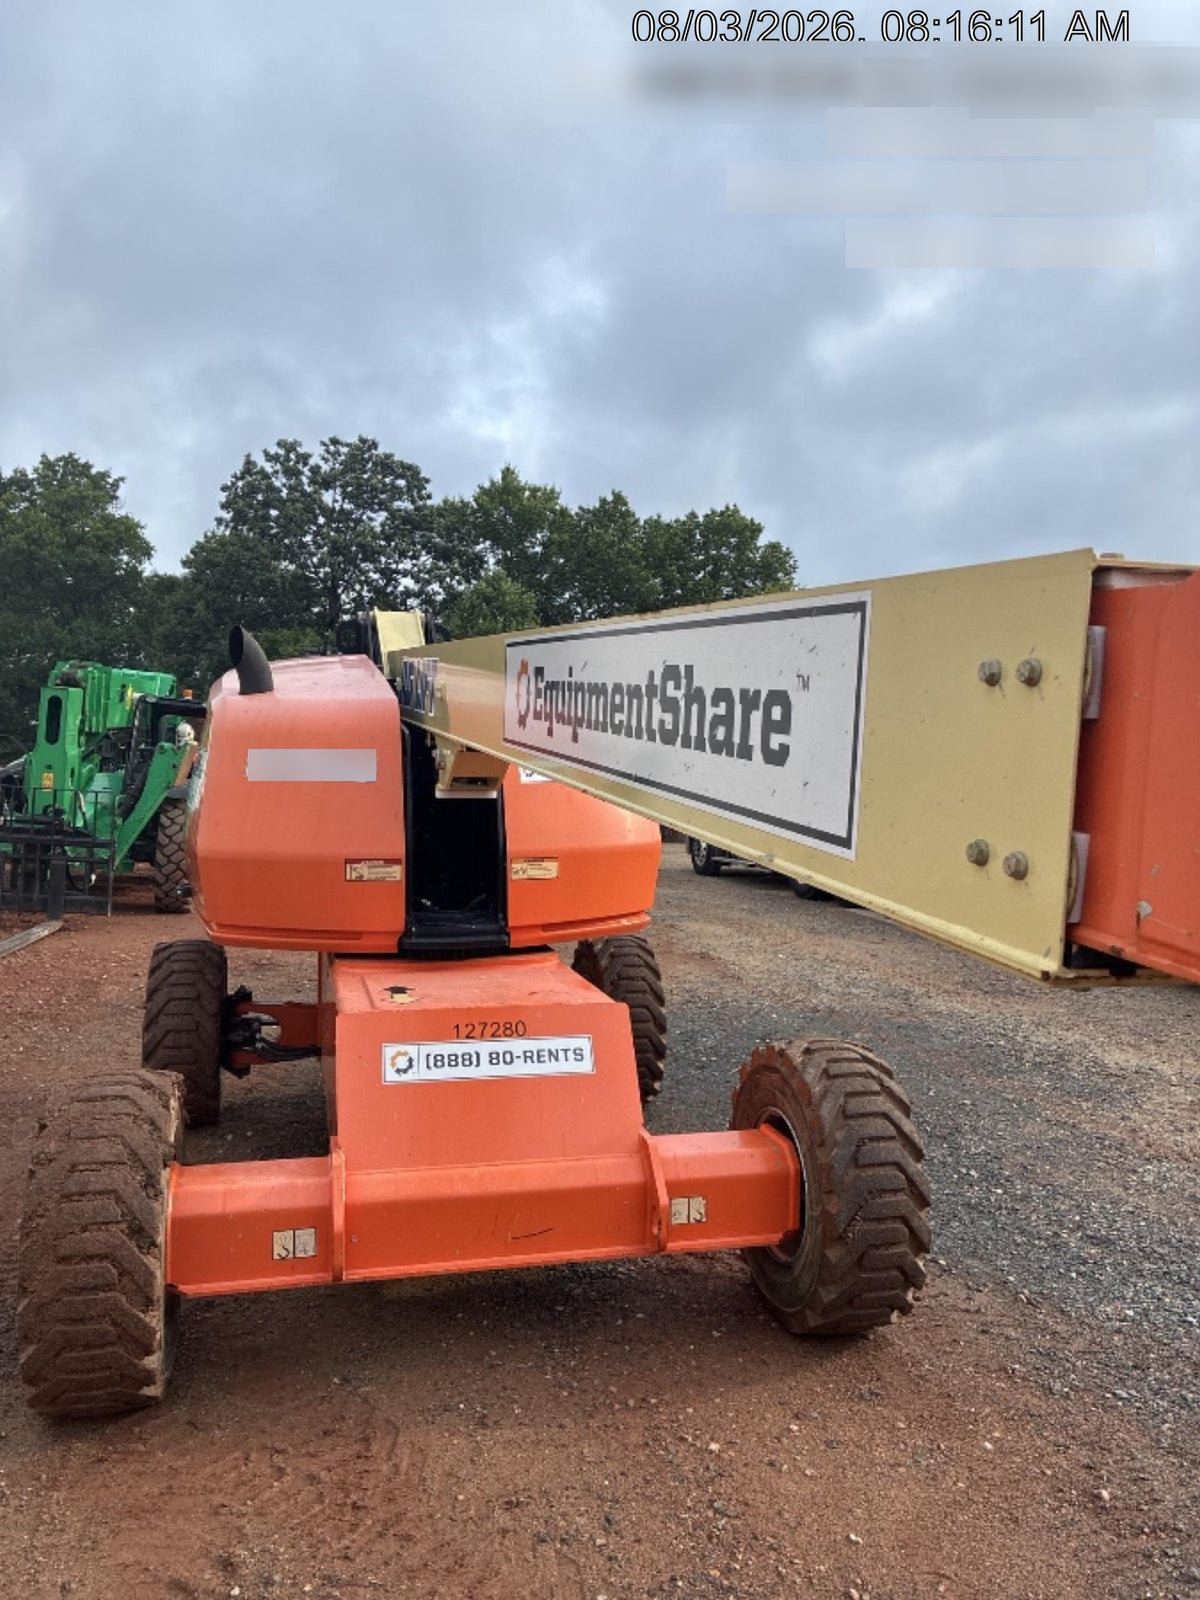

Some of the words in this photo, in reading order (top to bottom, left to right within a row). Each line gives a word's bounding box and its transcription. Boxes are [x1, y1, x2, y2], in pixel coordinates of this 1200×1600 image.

[533, 664, 792, 767] EquipmentShare
[452, 1020, 528, 1039] 127280
[488, 1047, 585, 1067] 80-RENTS
